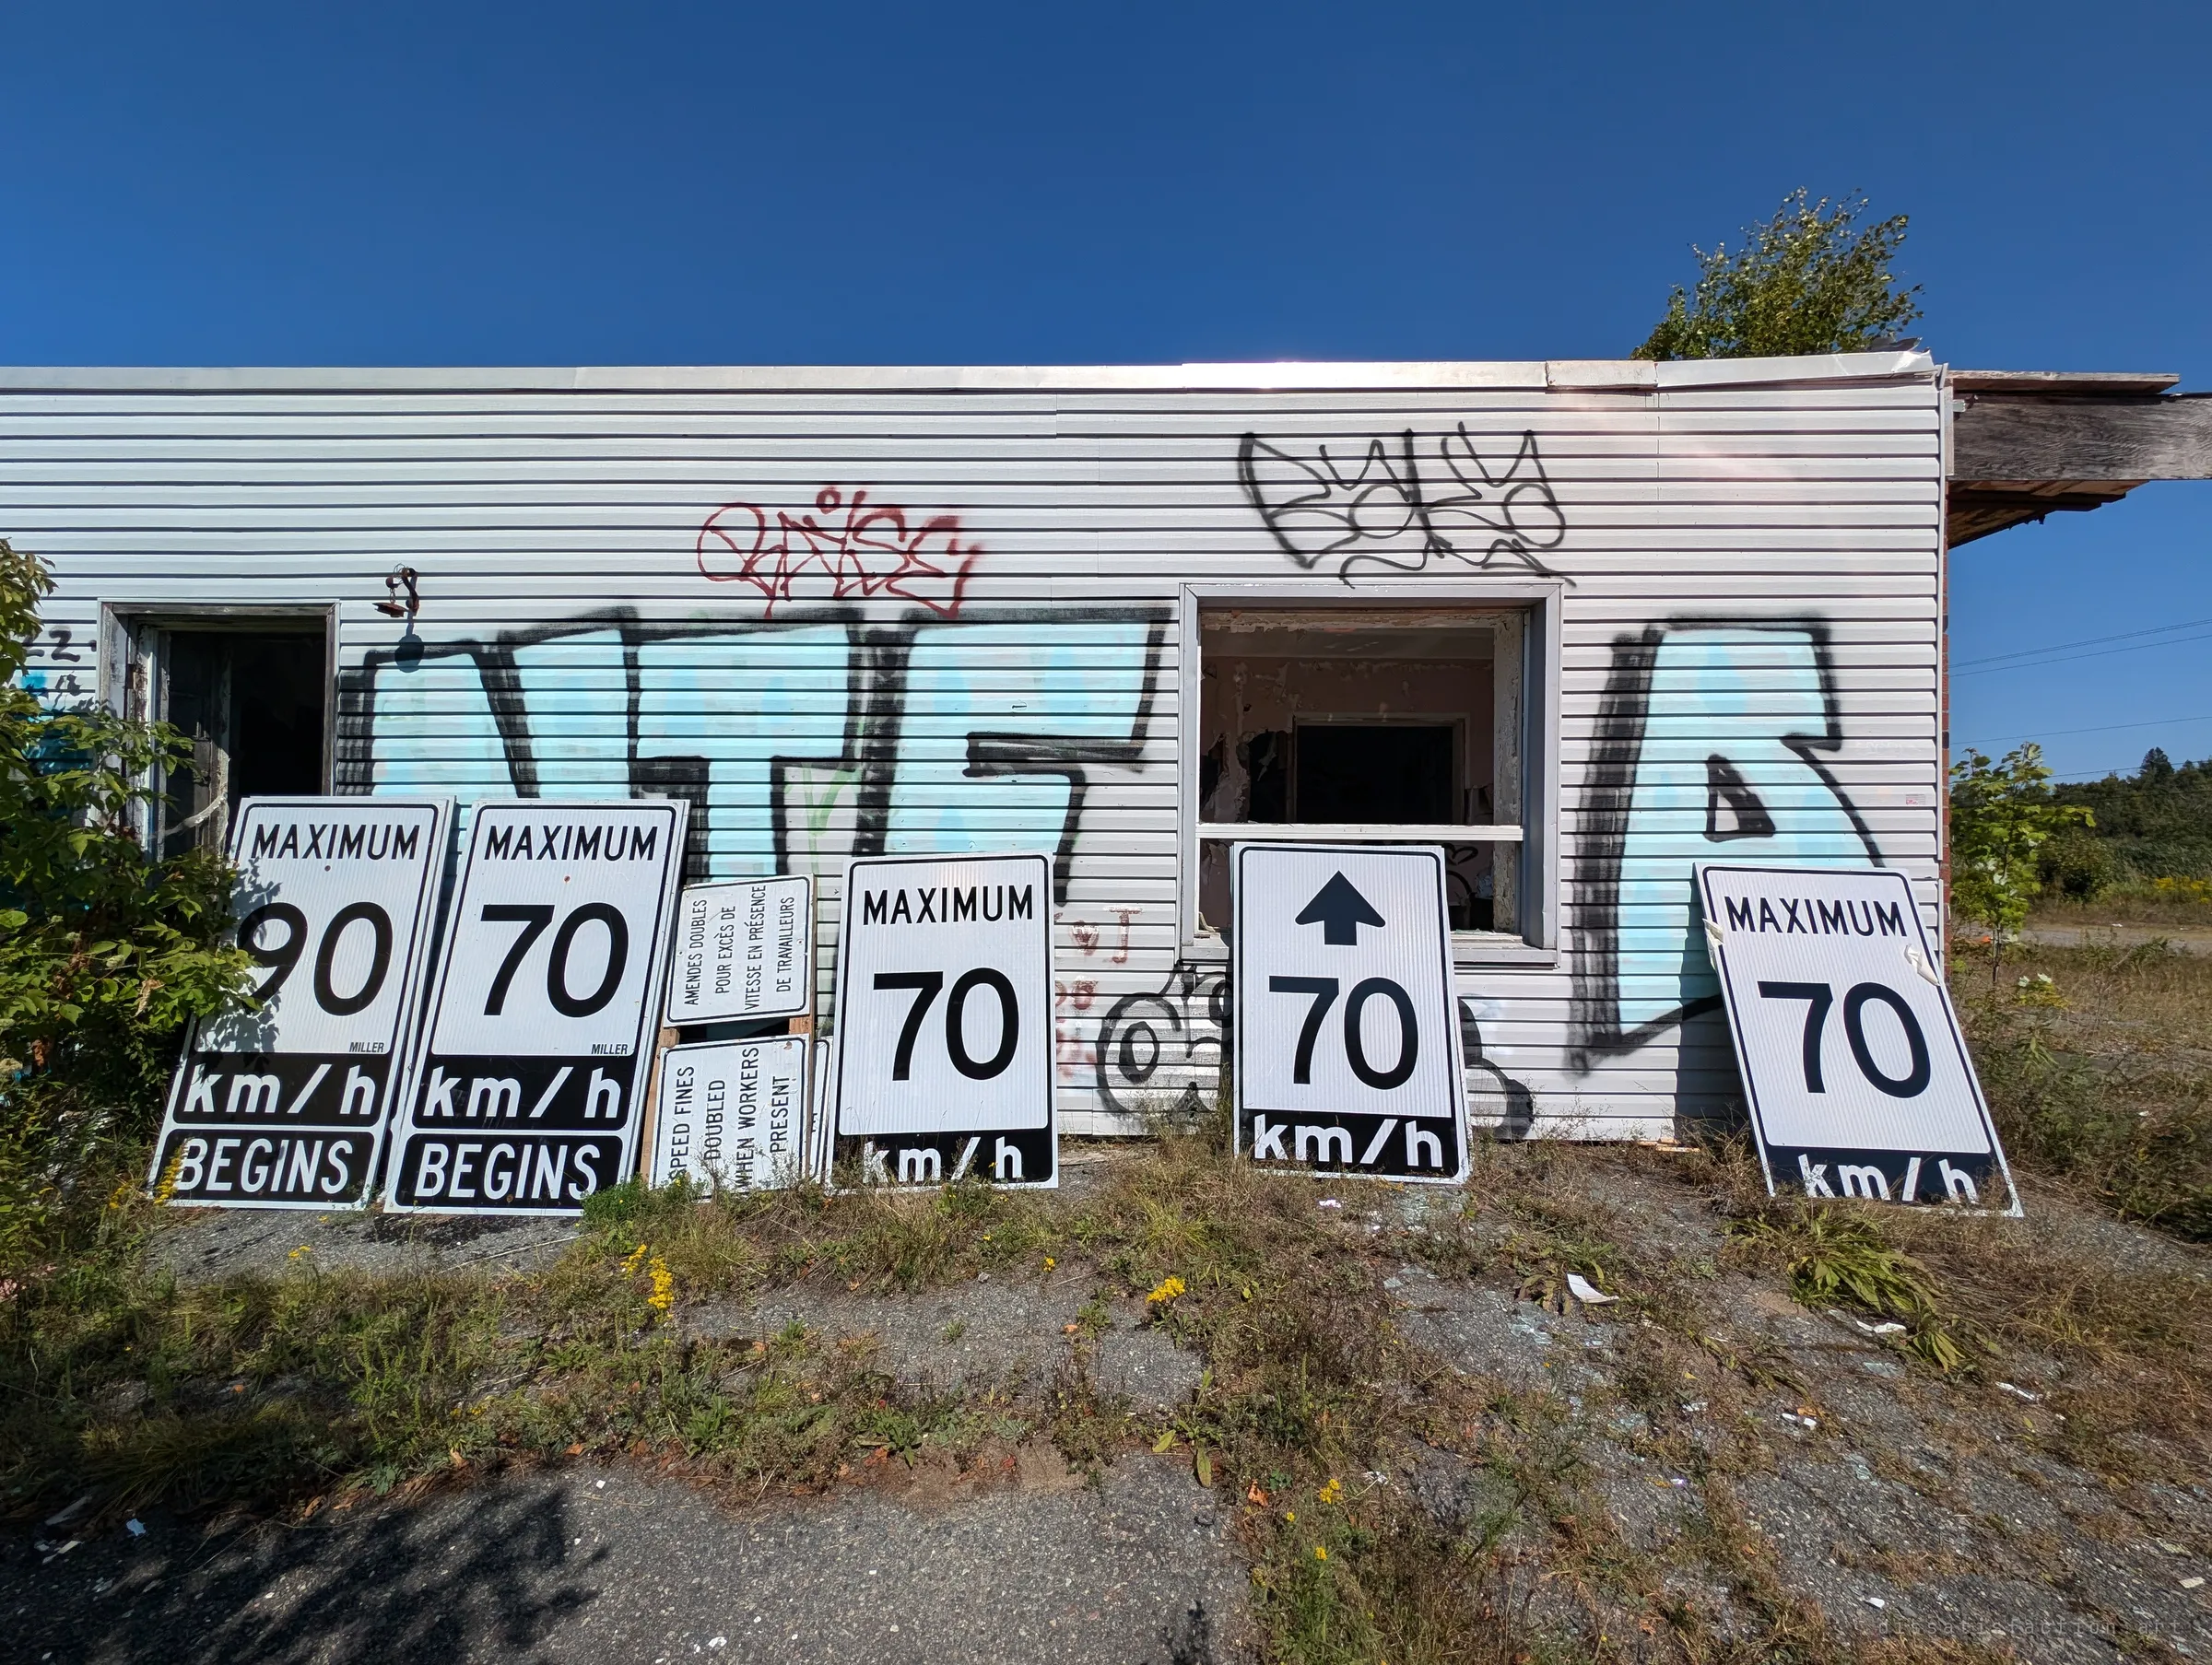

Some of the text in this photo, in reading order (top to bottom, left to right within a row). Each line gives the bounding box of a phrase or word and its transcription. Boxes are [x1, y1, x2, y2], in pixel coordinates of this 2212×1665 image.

[251, 824, 419, 861] MAXIMUM
[485, 825, 657, 862] MAXIMUM
[864, 885, 1032, 925] MAXIMUM
[1724, 897, 1907, 937] MAXIMUM
[237, 902, 393, 1016] 90
[480, 902, 629, 1017] 70
[684, 899, 708, 1006] AMENDES DOUBLES
[713, 906, 735, 993] POUR EXCÈS DE
[744, 885, 766, 1011] VITESSE EN PRÉSENCE
[776, 897, 794, 992] DE TRAVAILLEURS
[348, 1041, 385, 1053] MILLER
[591, 1043, 629, 1055] MILLER
[874, 967, 1018, 1081] 70
[1269, 976, 1418, 1090] 70
[1757, 980, 1931, 1099] 70
[183, 1063, 376, 1116] km/h
[423, 1065, 622, 1119] km/h
[668, 1066, 694, 1180] SPEED FINES
[703, 1080, 725, 1161] DOUBLED
[735, 1047, 759, 1190] WHEN WORKERS
[769, 1075, 790, 1154] PRESENT
[176, 1138, 353, 1194] BEGINS
[415, 1143, 600, 1201] BEGINS
[863, 1136, 1023, 1184] km/h
[1254, 1113, 1443, 1168] km/h
[1798, 1153, 1980, 1204] km/h
